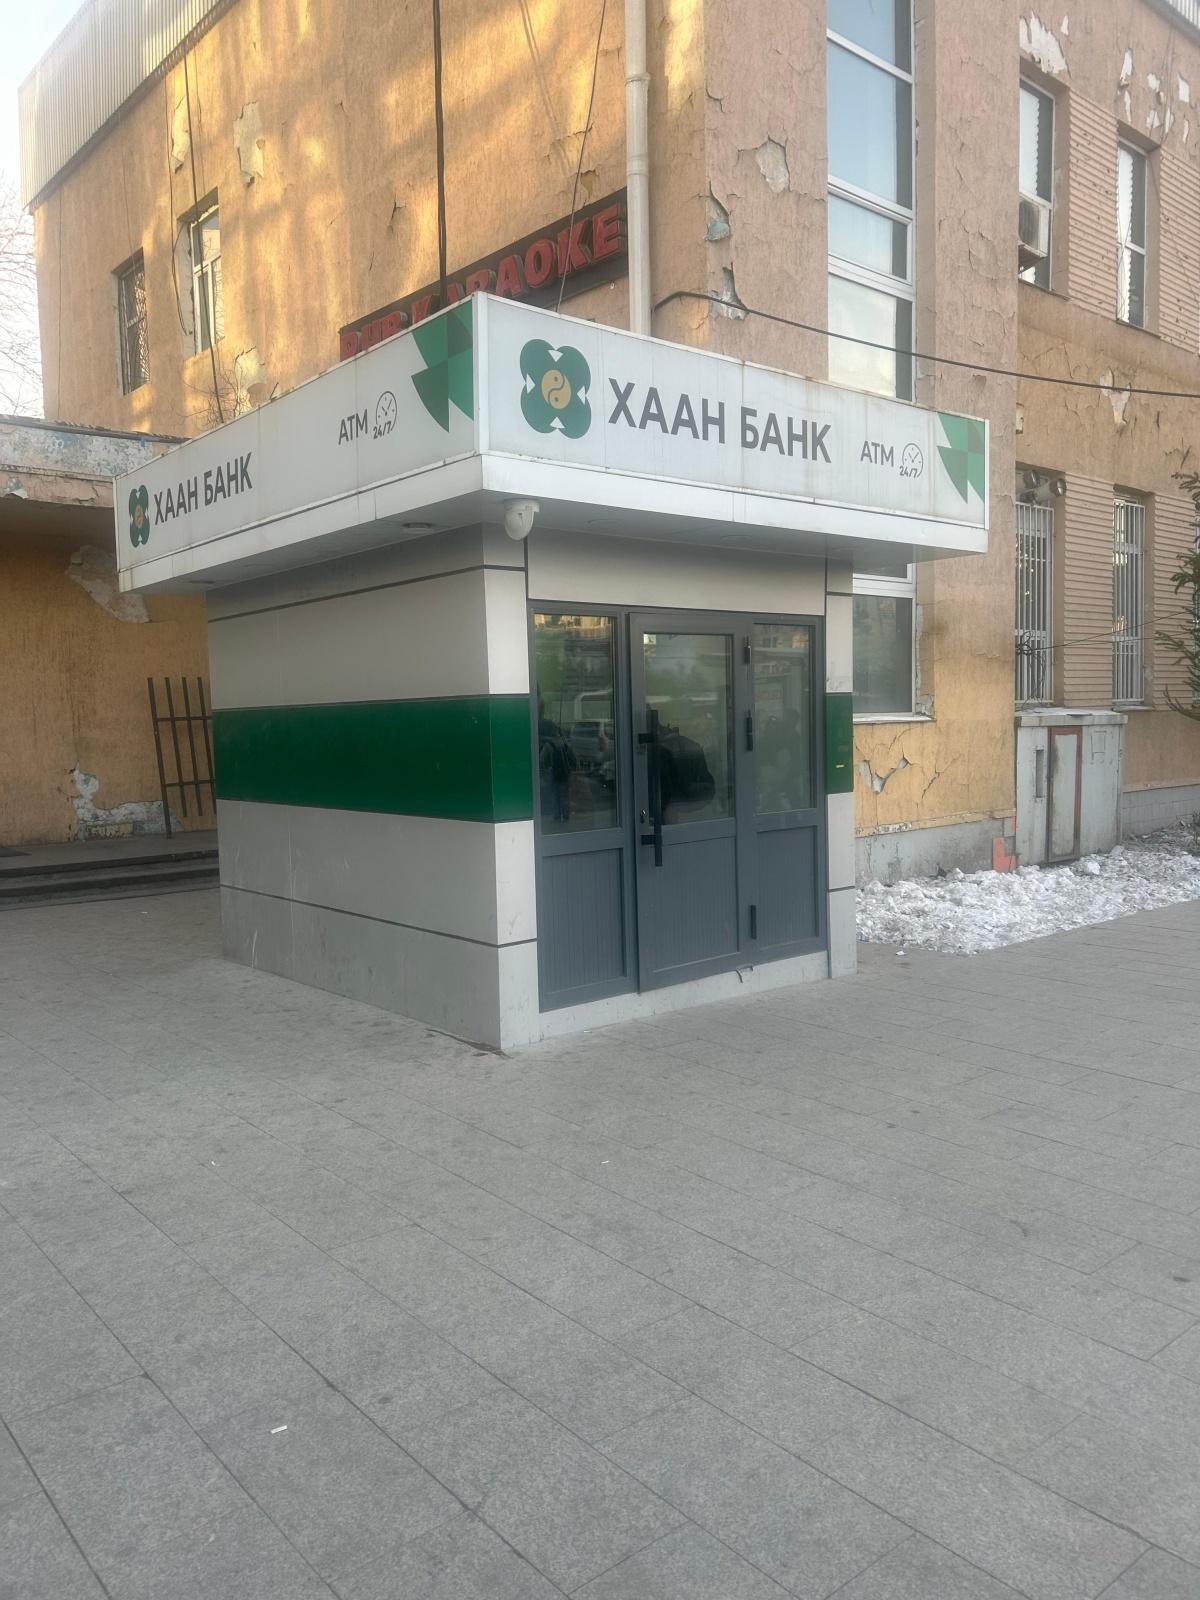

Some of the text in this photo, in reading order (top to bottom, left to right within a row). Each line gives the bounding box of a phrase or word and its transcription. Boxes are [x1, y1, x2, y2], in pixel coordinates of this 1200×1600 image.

[338, 408, 392, 446] ATM 24/7
[607, 377, 832, 463] ХААН БАНК
[860, 440, 918, 478] ATM 24/7
[153, 451, 253, 526] ХААН БАНК
